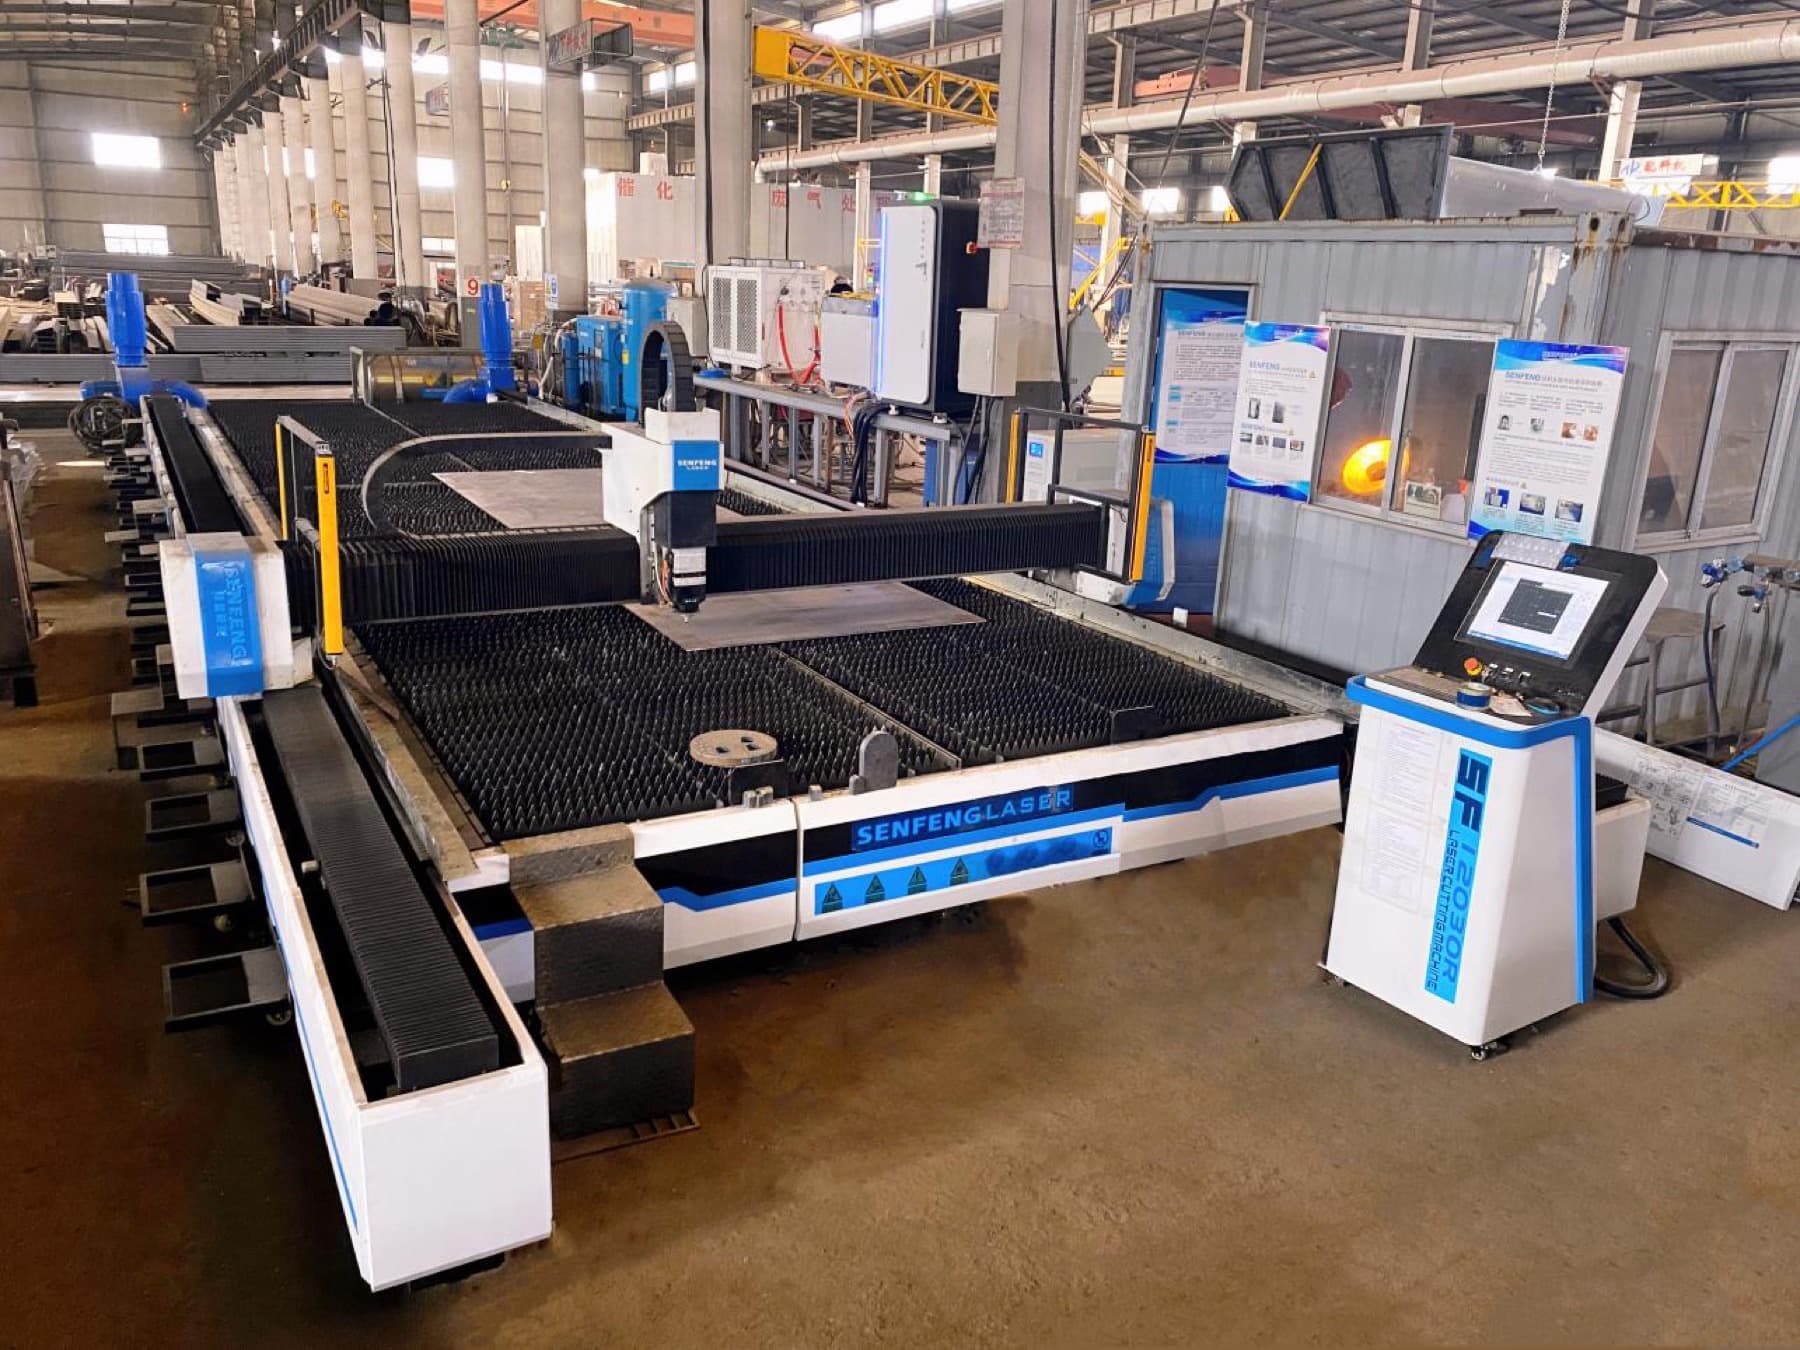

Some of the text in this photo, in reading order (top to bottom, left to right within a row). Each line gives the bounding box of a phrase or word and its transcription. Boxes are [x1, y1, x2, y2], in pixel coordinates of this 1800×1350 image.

[617, 177, 674, 201] 催化
[467, 279, 479, 295] 9
[1454, 752, 1489, 833] SF
